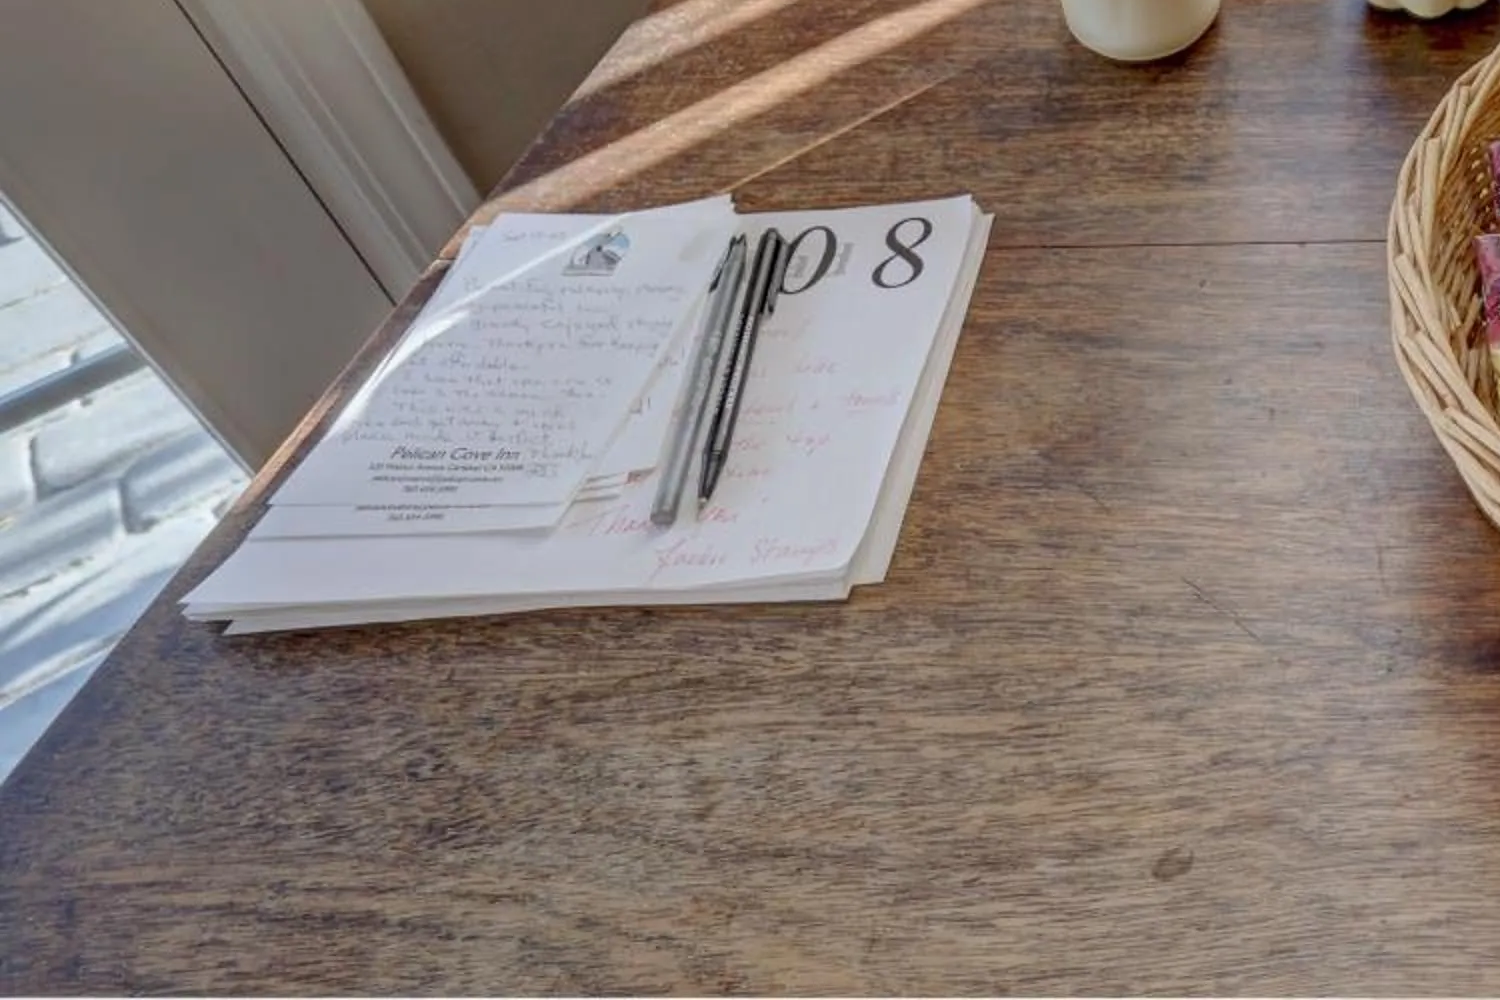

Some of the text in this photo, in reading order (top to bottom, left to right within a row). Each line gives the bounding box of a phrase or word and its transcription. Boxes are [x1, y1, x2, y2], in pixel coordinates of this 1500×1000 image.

[390, 446, 521, 461] Pelican Cove Inn
